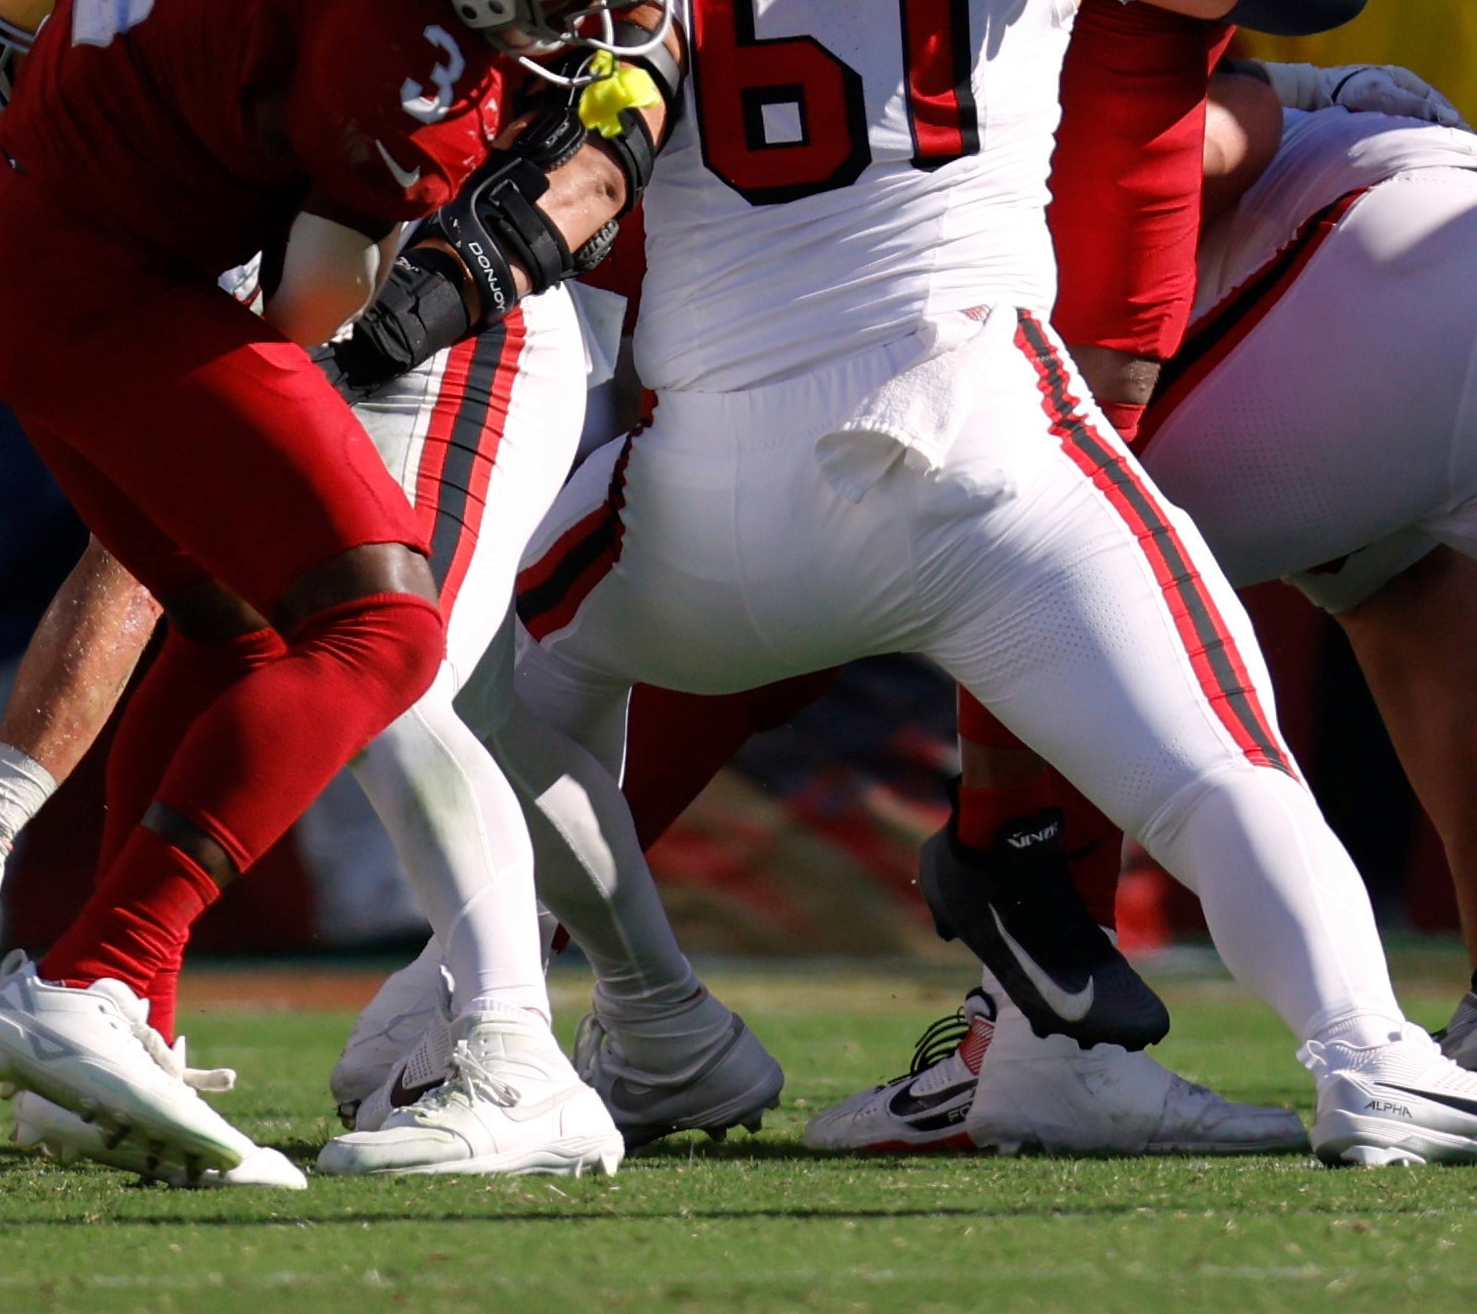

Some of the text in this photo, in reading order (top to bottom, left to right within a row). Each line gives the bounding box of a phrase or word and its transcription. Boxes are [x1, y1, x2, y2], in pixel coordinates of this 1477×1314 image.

[398, 23, 466, 125] 3
[467, 240, 507, 316] DONJOY
[1364, 1100, 1414, 1119] ALPHA
